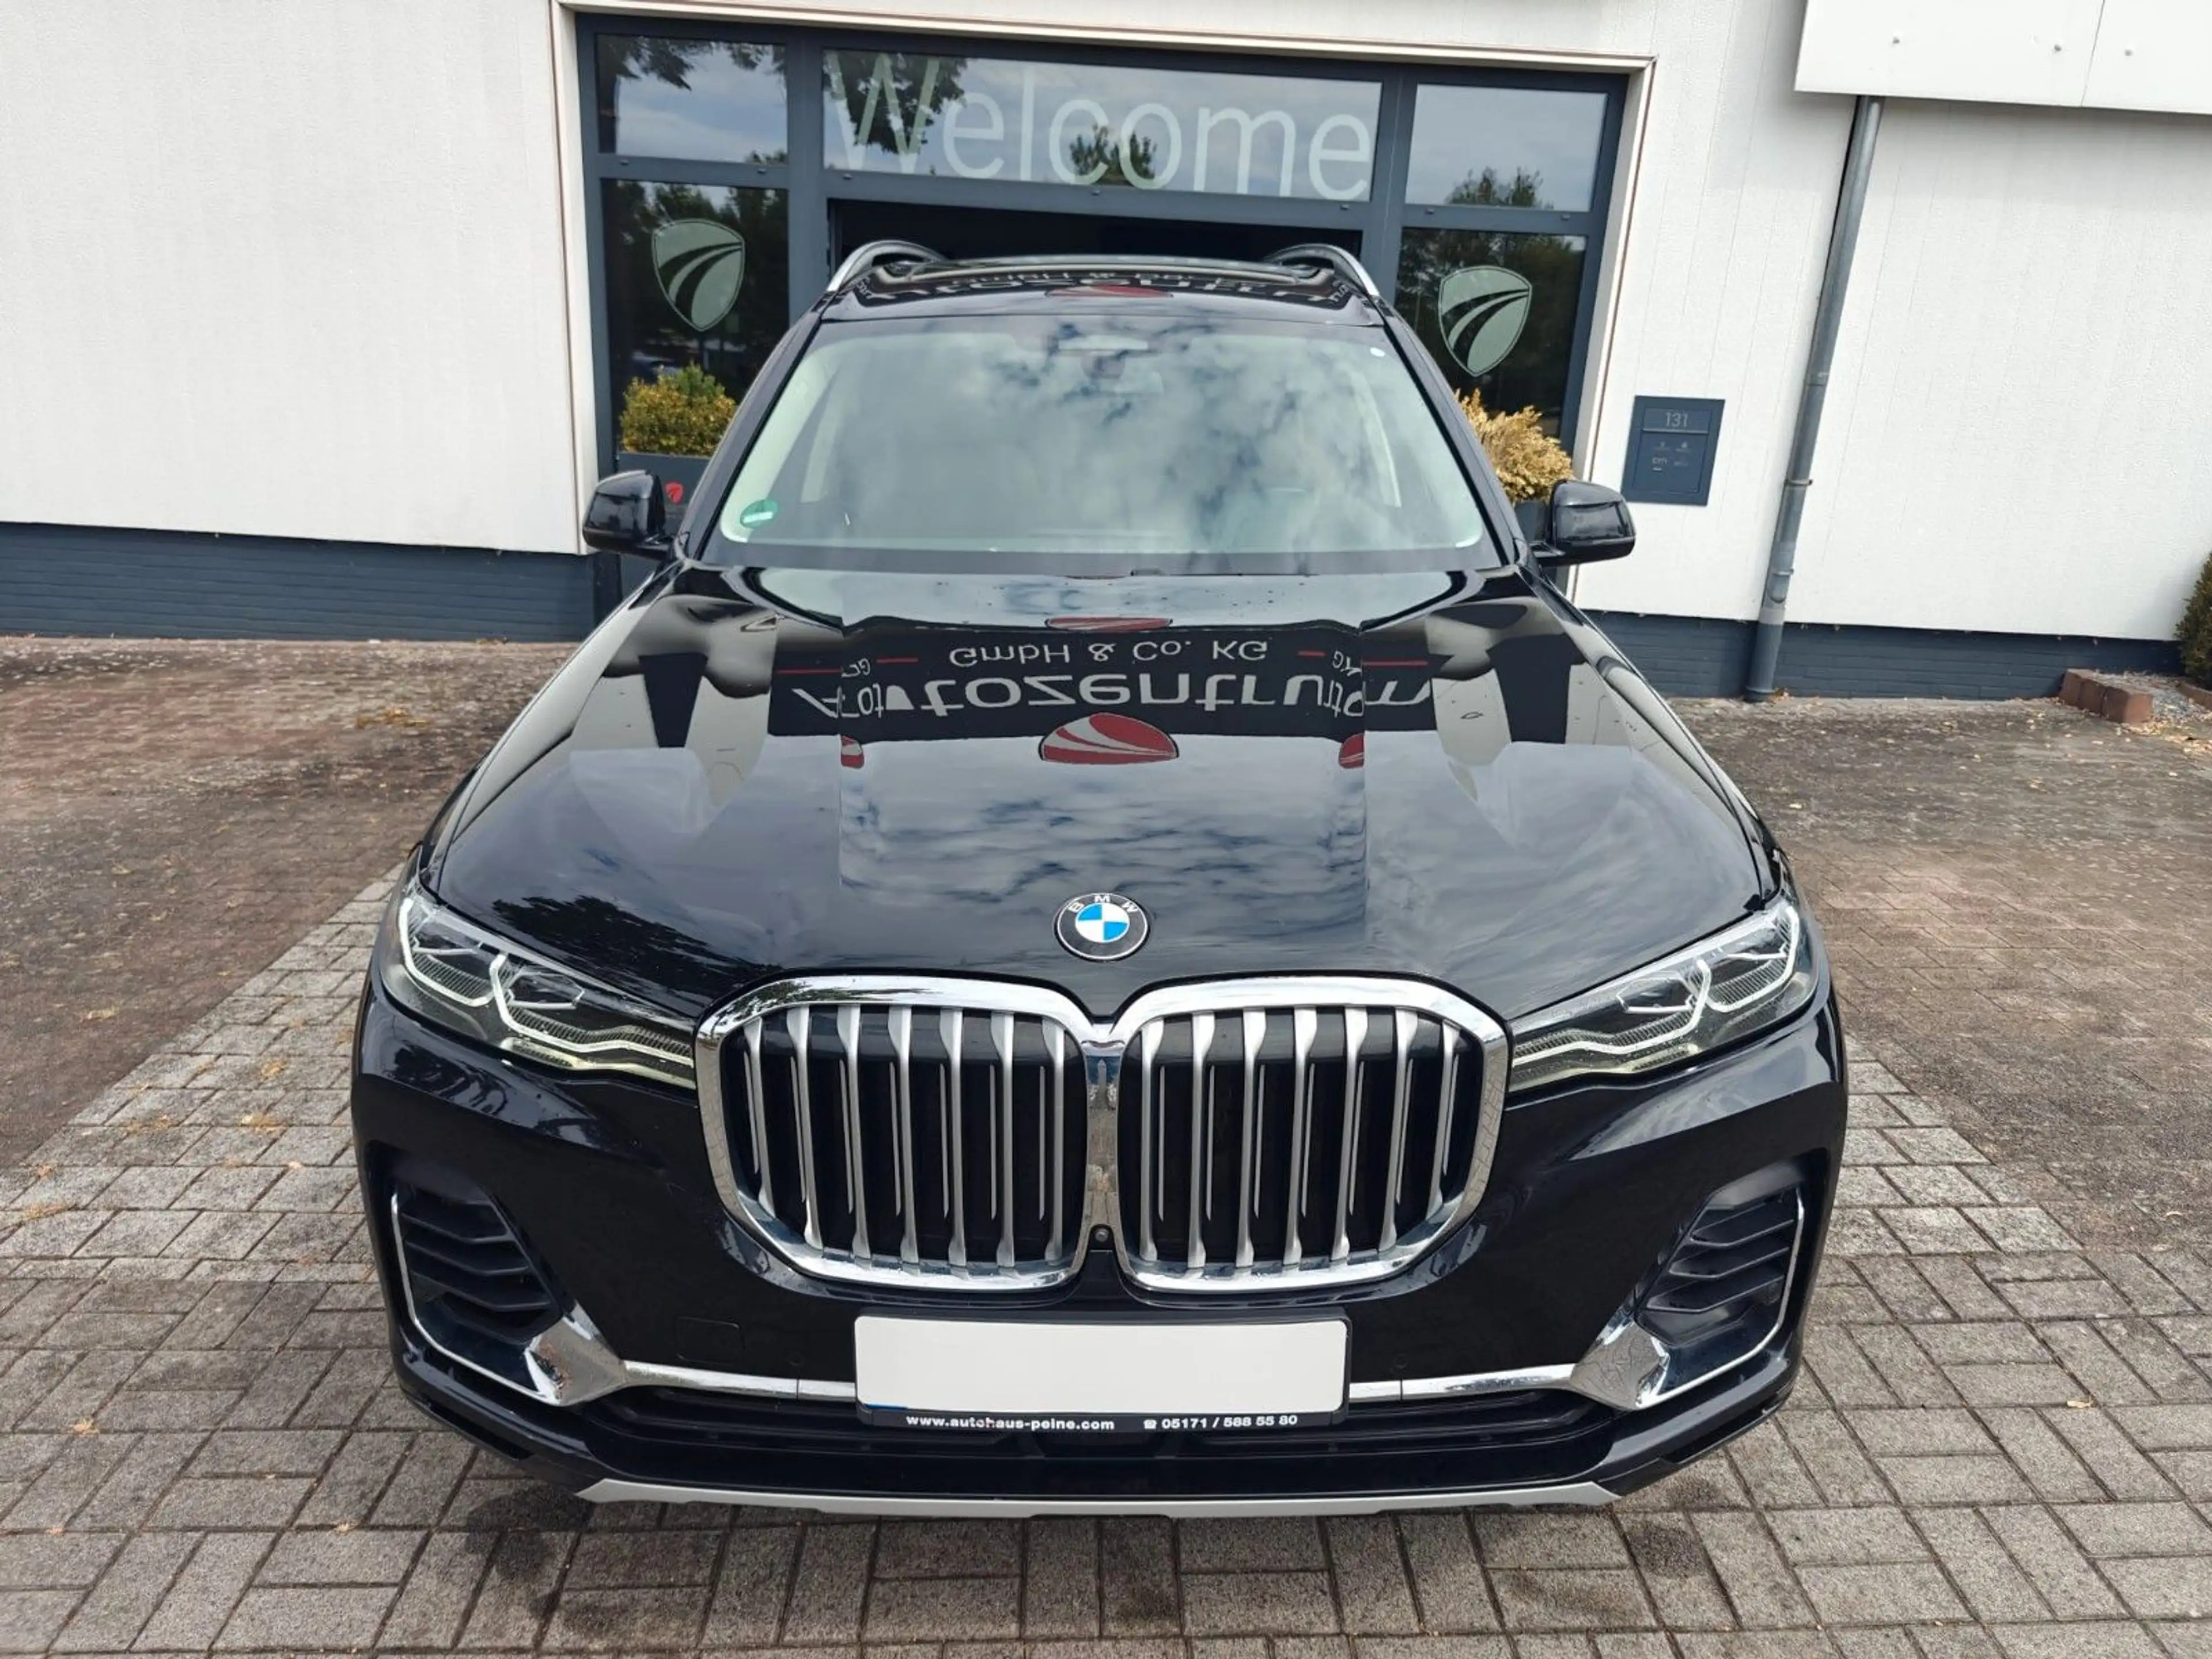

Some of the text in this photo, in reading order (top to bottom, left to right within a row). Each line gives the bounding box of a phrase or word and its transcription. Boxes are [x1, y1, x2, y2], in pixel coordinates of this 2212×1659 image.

[825, 52, 1372, 202] Welcome
[1665, 412, 1688, 427] 131
[1067, 895, 1138, 912] BMW
[906, 1415, 1297, 1431] www.autohaus-peine.com 05171 / 588 55 80
